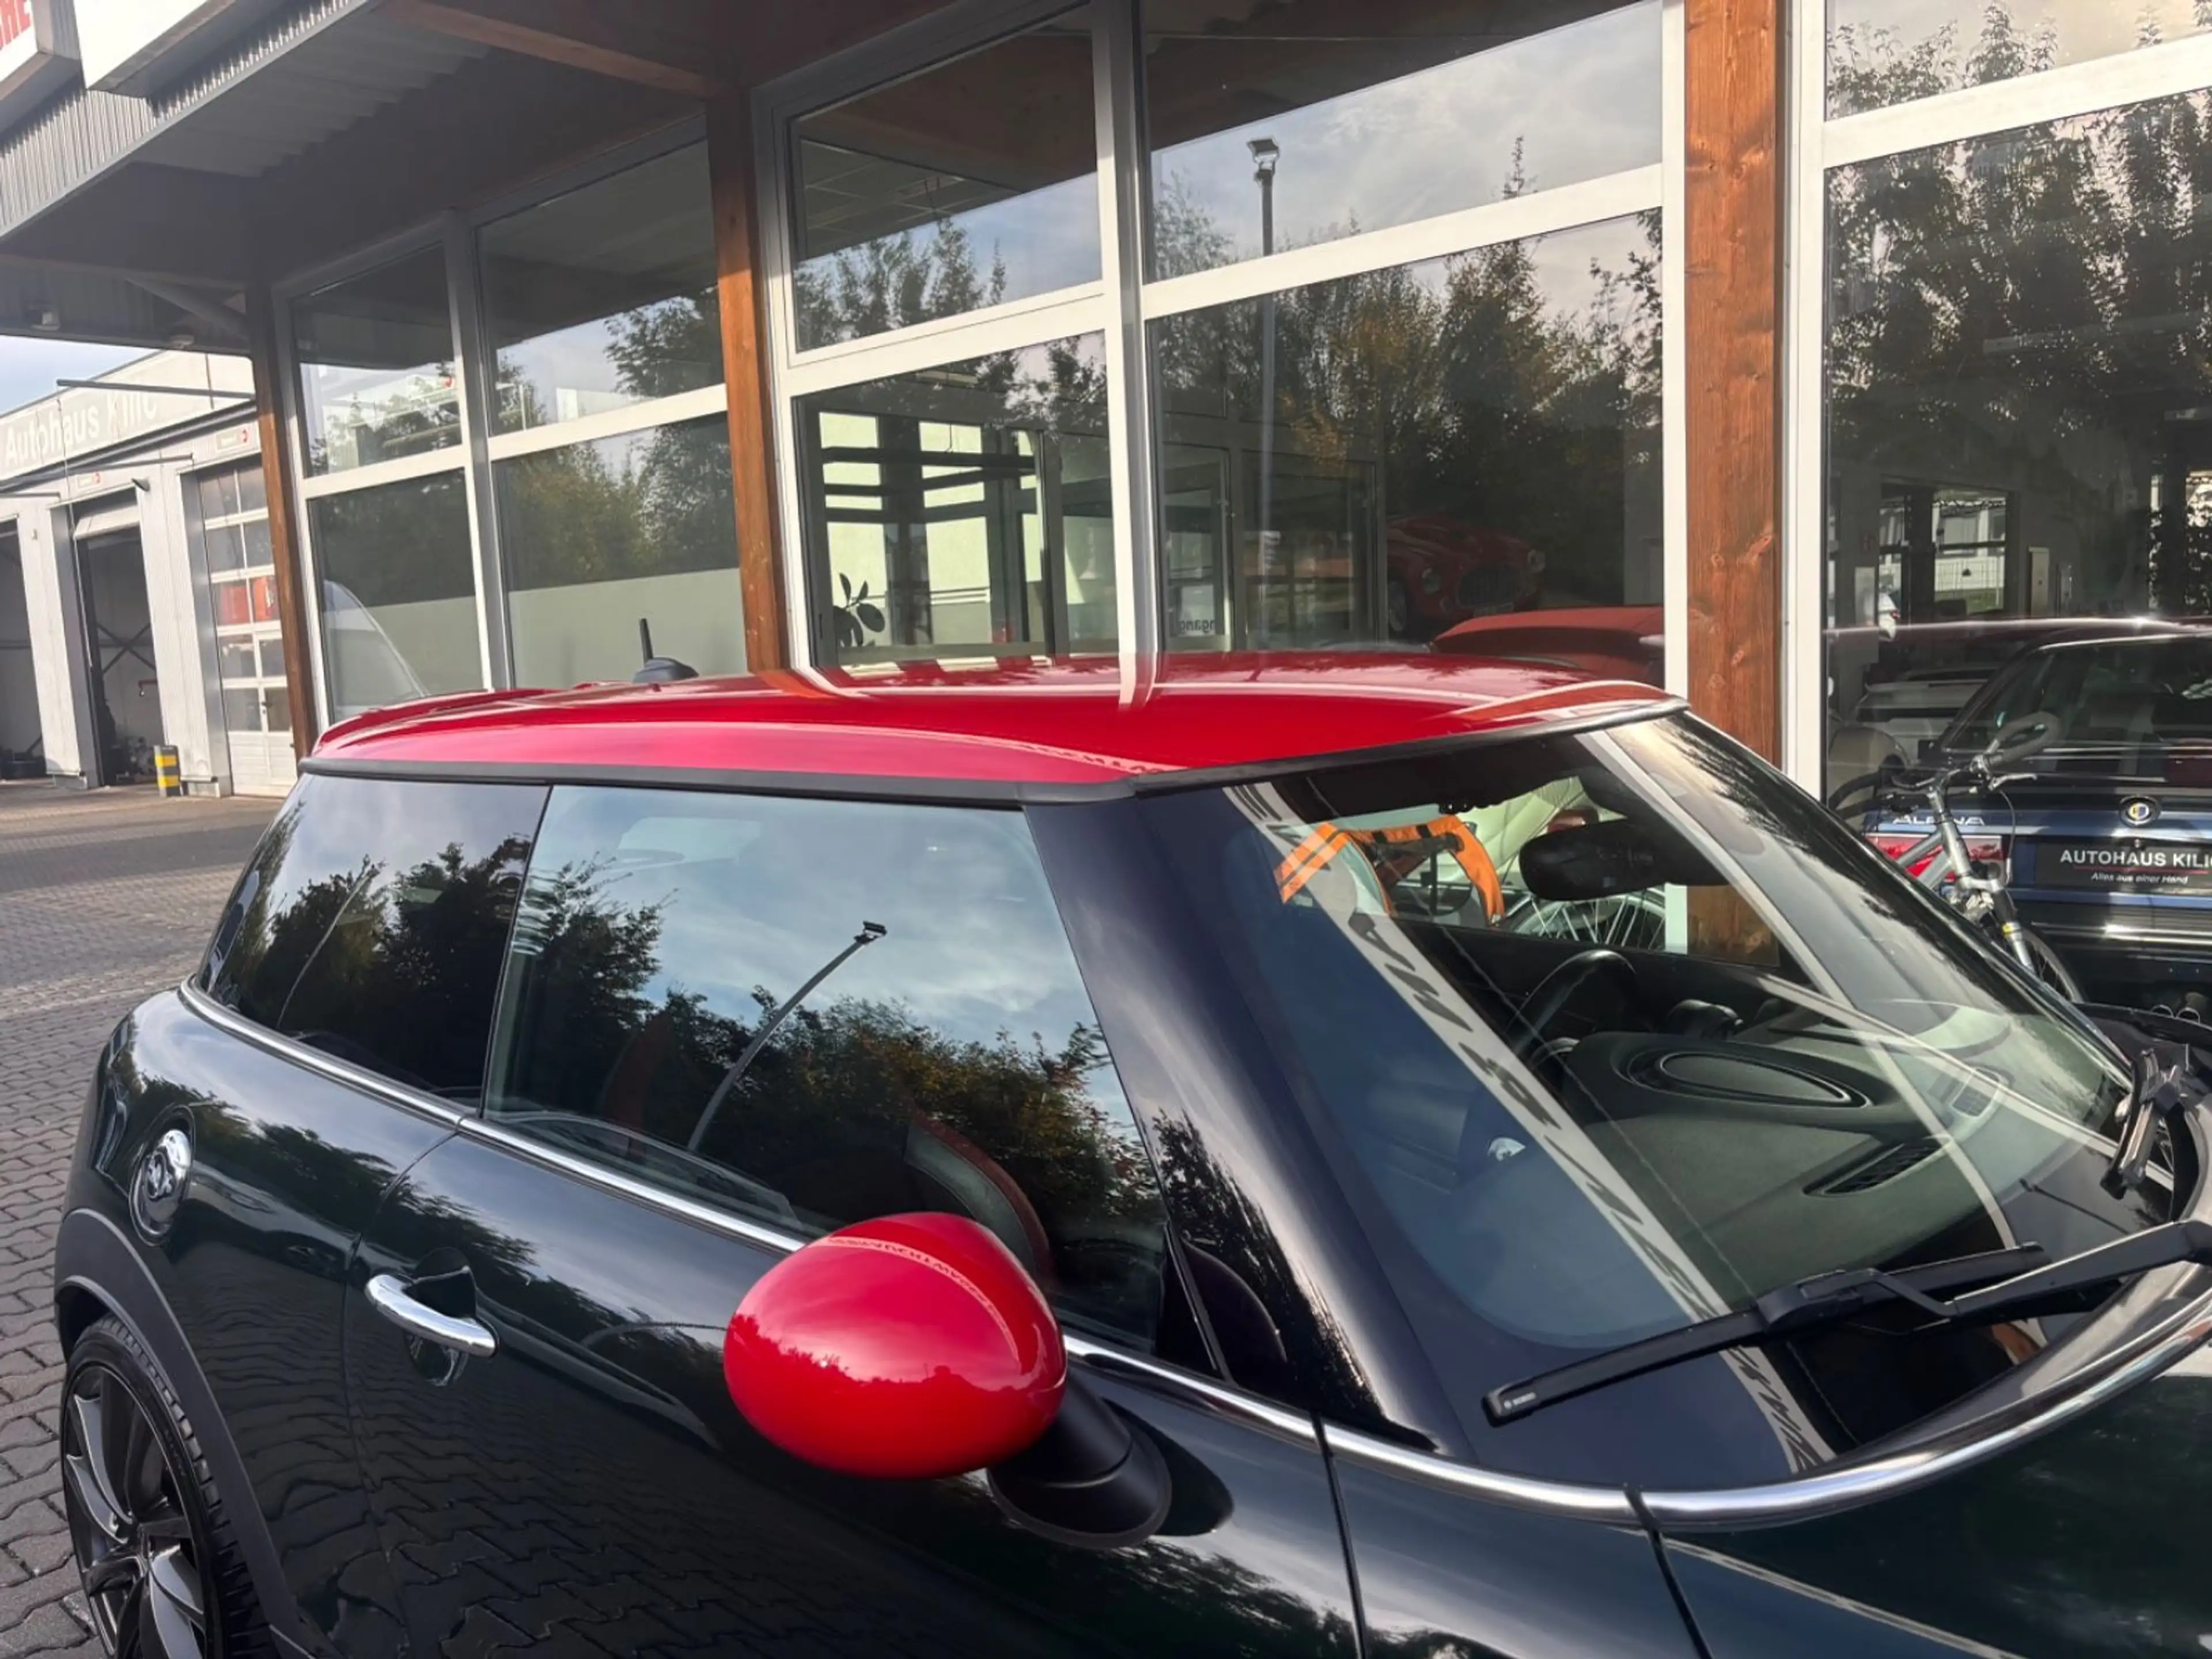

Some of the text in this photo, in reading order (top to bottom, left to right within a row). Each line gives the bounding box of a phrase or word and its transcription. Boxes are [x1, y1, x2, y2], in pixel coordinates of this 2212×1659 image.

[5, 405, 100, 467] Autohaus
[2060, 849, 2212, 869] AUTOHAUS KILI
[2091, 872, 2188, 885] Alles aus einer Hand
